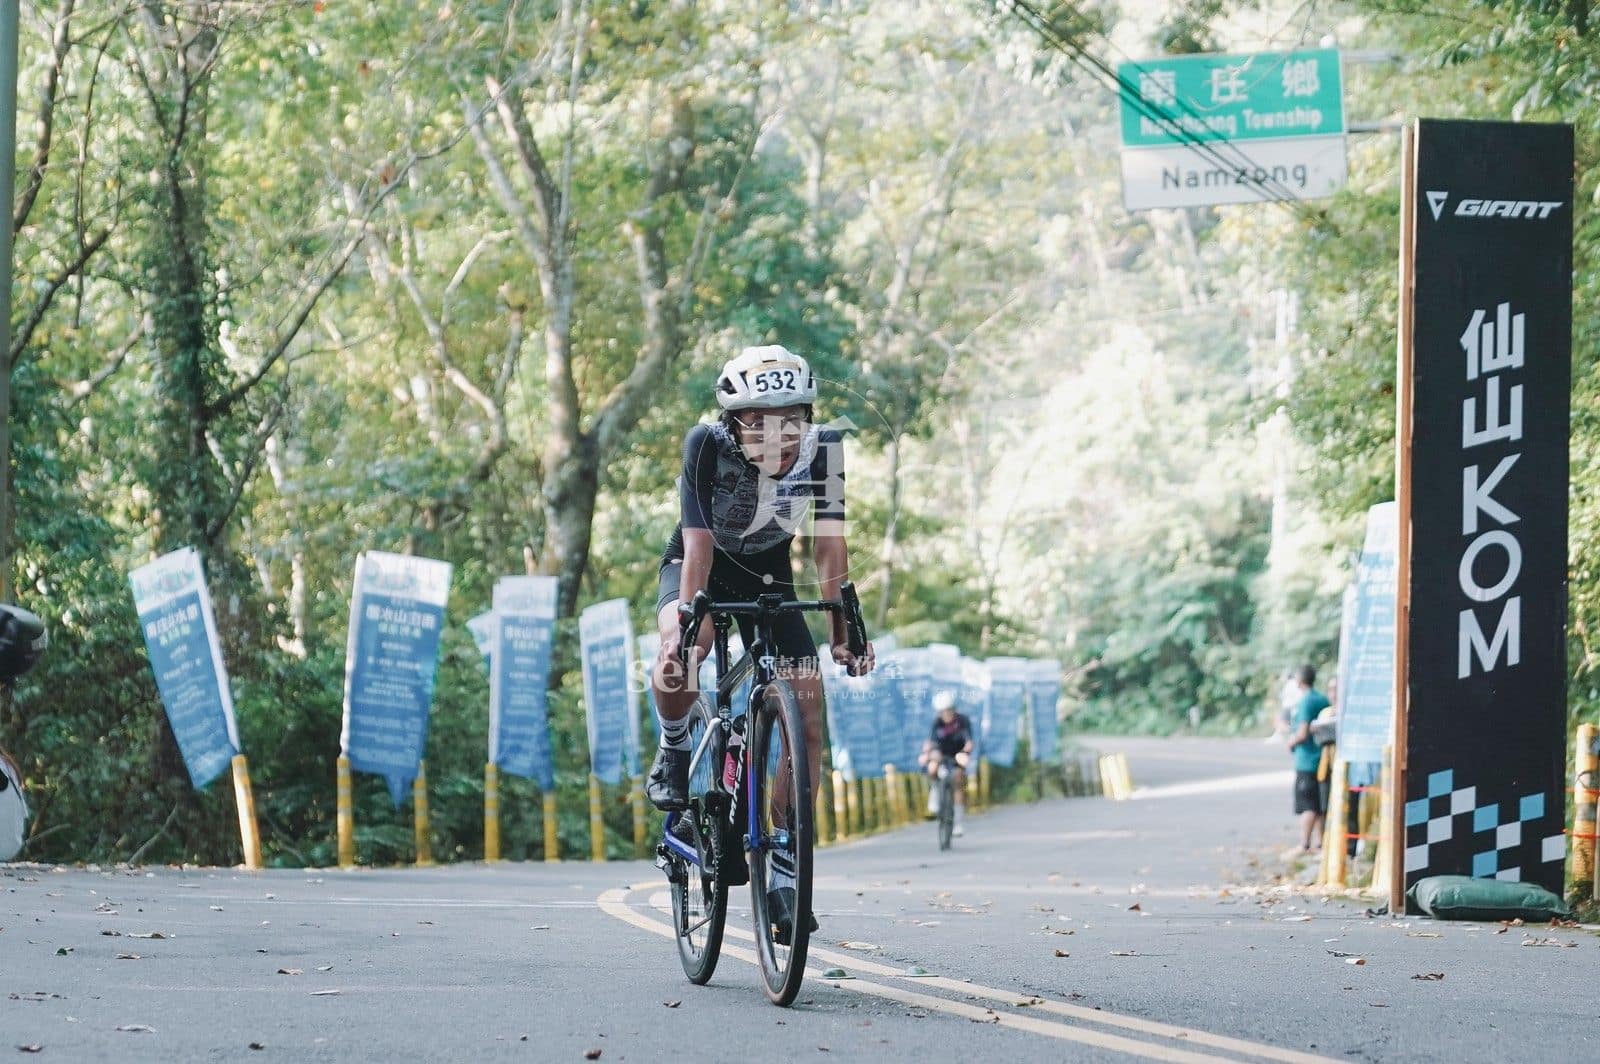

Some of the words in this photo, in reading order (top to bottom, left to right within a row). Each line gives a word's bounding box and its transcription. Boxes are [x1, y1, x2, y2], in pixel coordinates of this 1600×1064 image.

[1139, 59, 1320, 106] 南庄鄉
[1242, 106, 1322, 129] Township
[1162, 164, 1307, 190] Namzong
[1454, 199, 1563, 219] GIANT
[755, 370, 796, 393] 532
